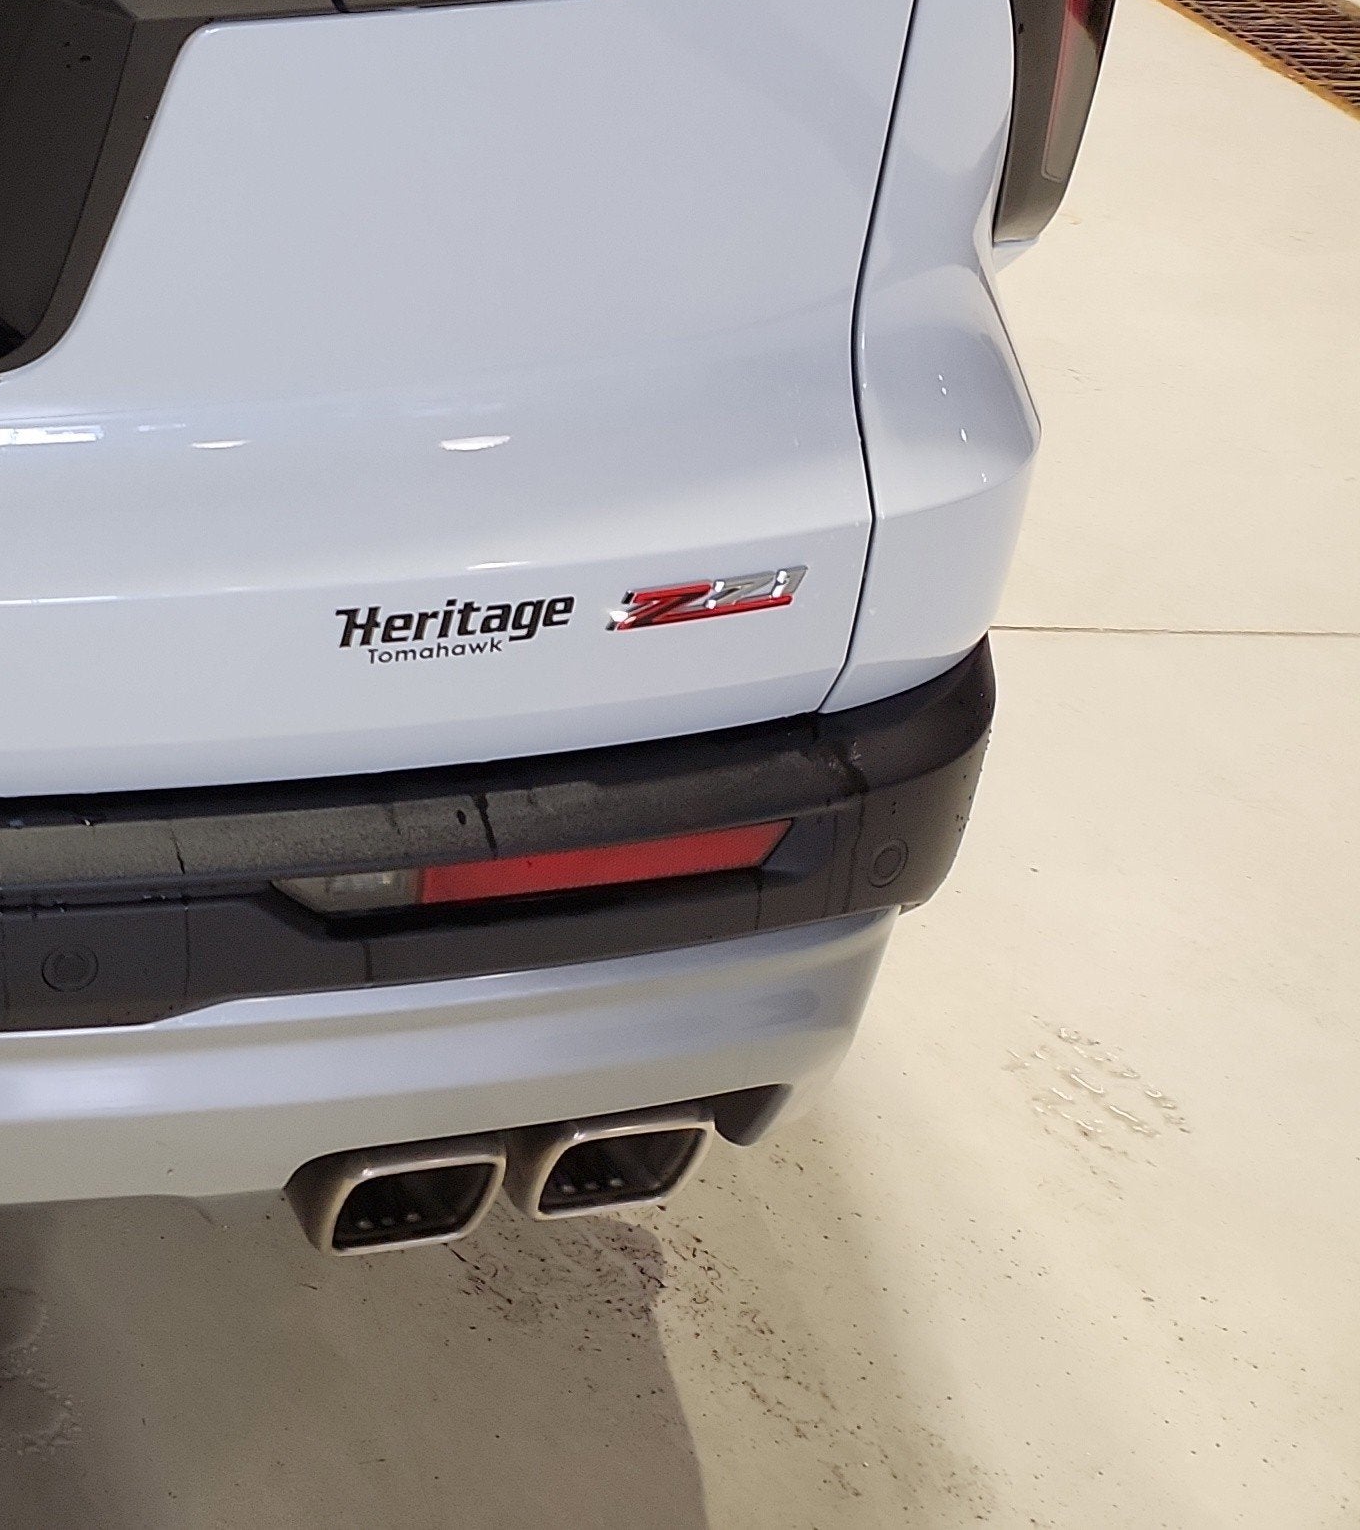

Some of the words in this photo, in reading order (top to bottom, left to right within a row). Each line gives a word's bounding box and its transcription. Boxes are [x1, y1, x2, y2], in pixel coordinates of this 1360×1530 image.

[334, 595, 575, 648] Heritage
[606, 565, 808, 631] Z71
[367, 637, 504, 665] Tomahawk
